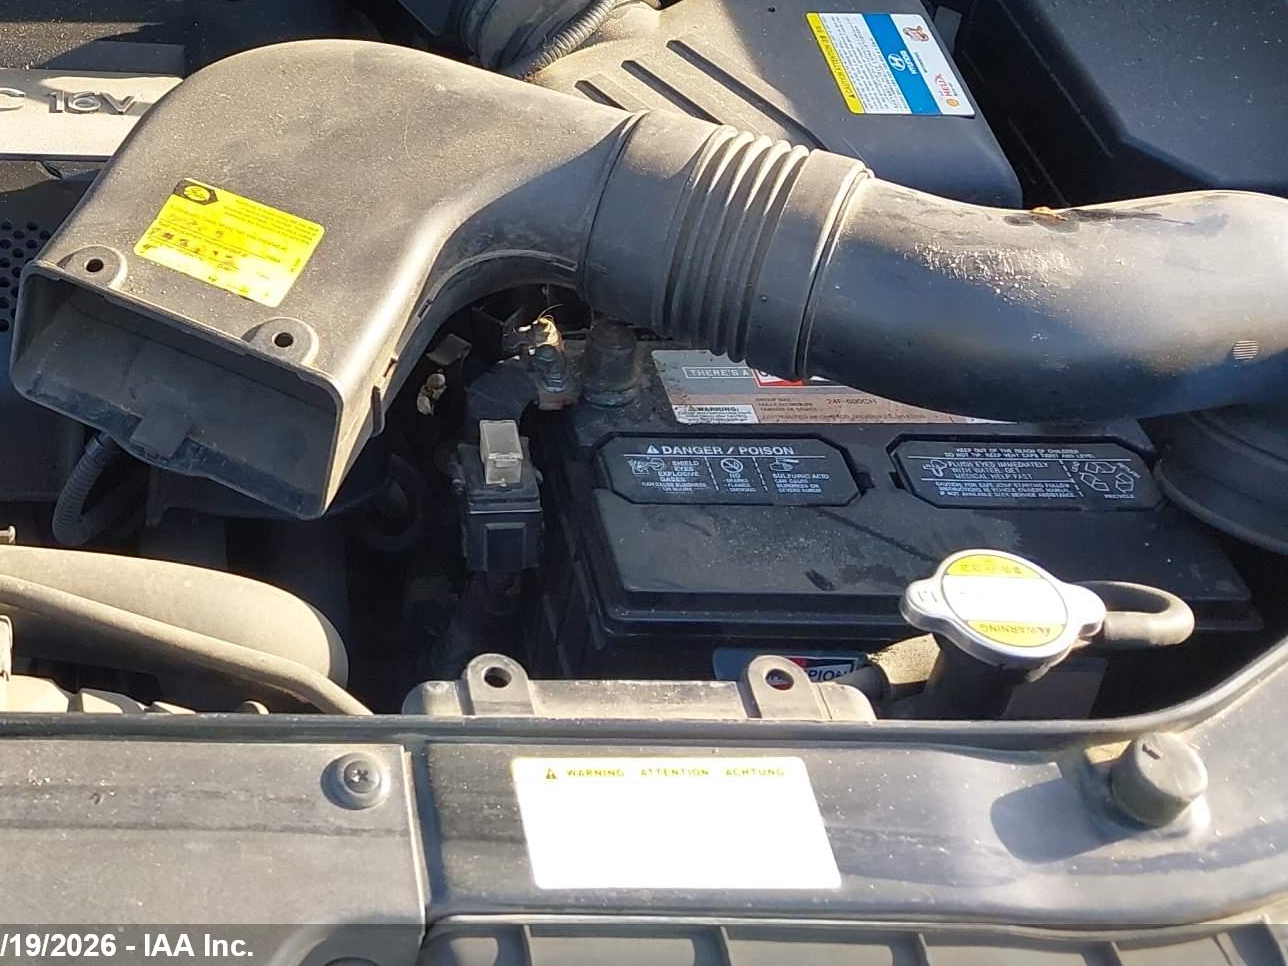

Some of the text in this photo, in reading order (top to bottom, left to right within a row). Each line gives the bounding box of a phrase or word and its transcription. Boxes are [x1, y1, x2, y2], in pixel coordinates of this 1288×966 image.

[47, 89, 138, 115] 16V
[689, 369, 739, 377] THERE'S
[661, 445, 794, 455] DANGER / POISON
[979, 623, 1042, 638] WARNING
[566, 768, 784, 777] WARNING ATTENTION ACHTUNG
